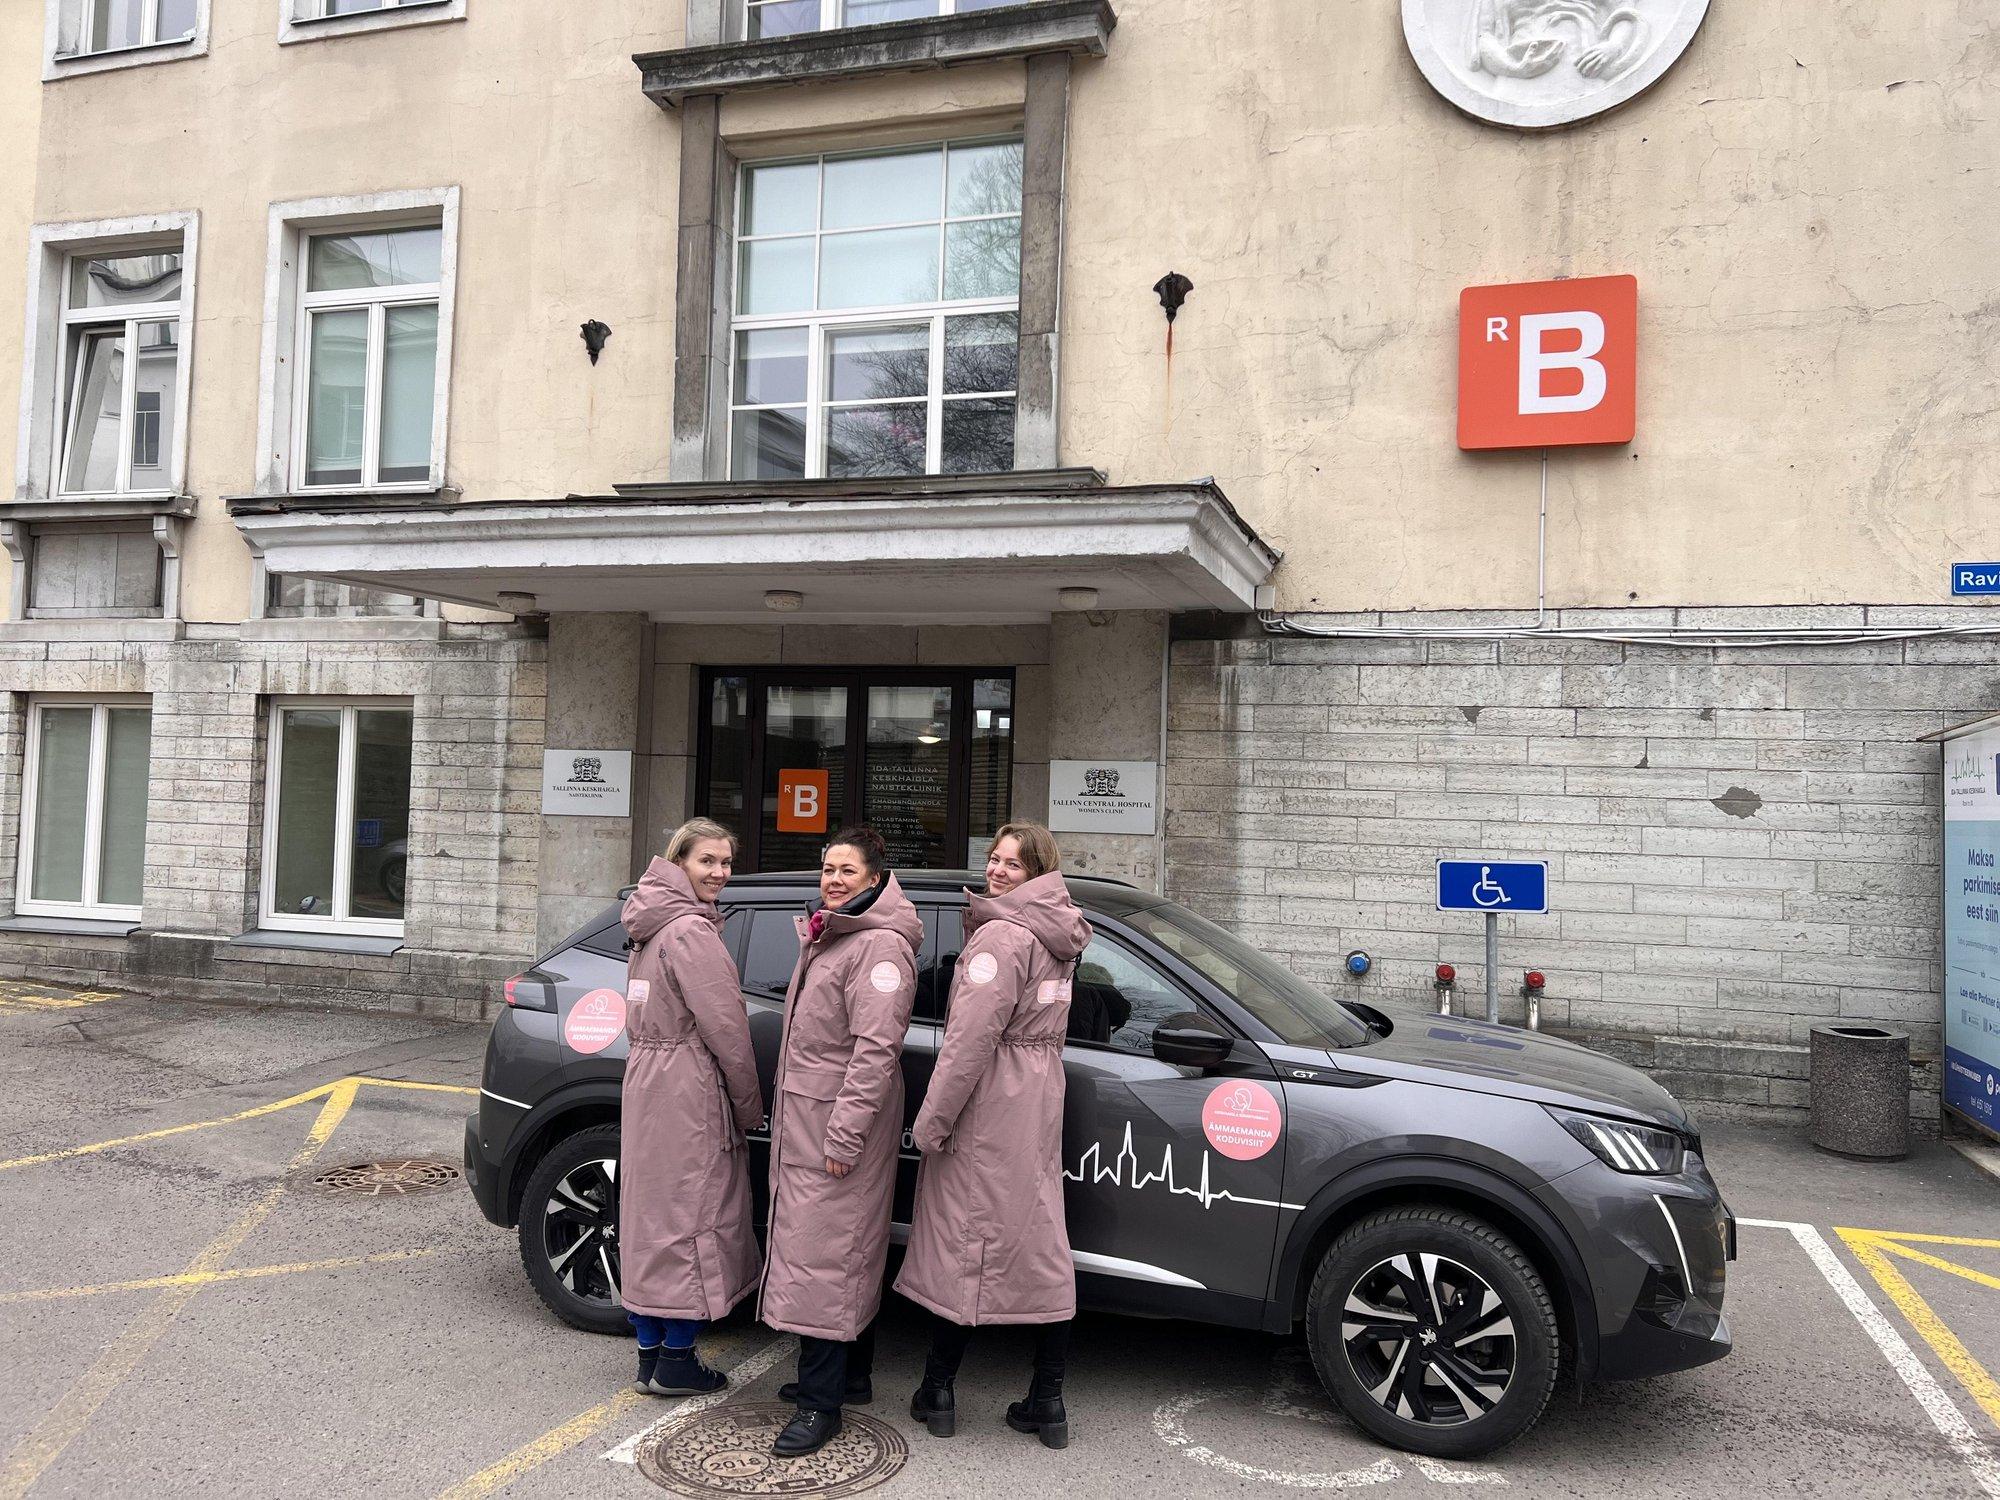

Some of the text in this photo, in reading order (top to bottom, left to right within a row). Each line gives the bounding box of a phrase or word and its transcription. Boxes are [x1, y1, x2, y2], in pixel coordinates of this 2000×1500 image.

[1486, 310, 1607, 415] R B
[872, 765, 938, 773] IDA-TALLINNA
[872, 774, 935, 783] KESKHAIGLA
[784, 784, 819, 818] R B
[1968, 849, 1994, 867] Maksa
[1963, 875, 2000, 896] parkimise
[1966, 904, 1999, 923] eest siin
[1292, 1070, 1318, 1079] GT
[1208, 1121, 1273, 1138] ÄMMAEMANDA
[1216, 1134, 1264, 1147] KODUVISIIT
